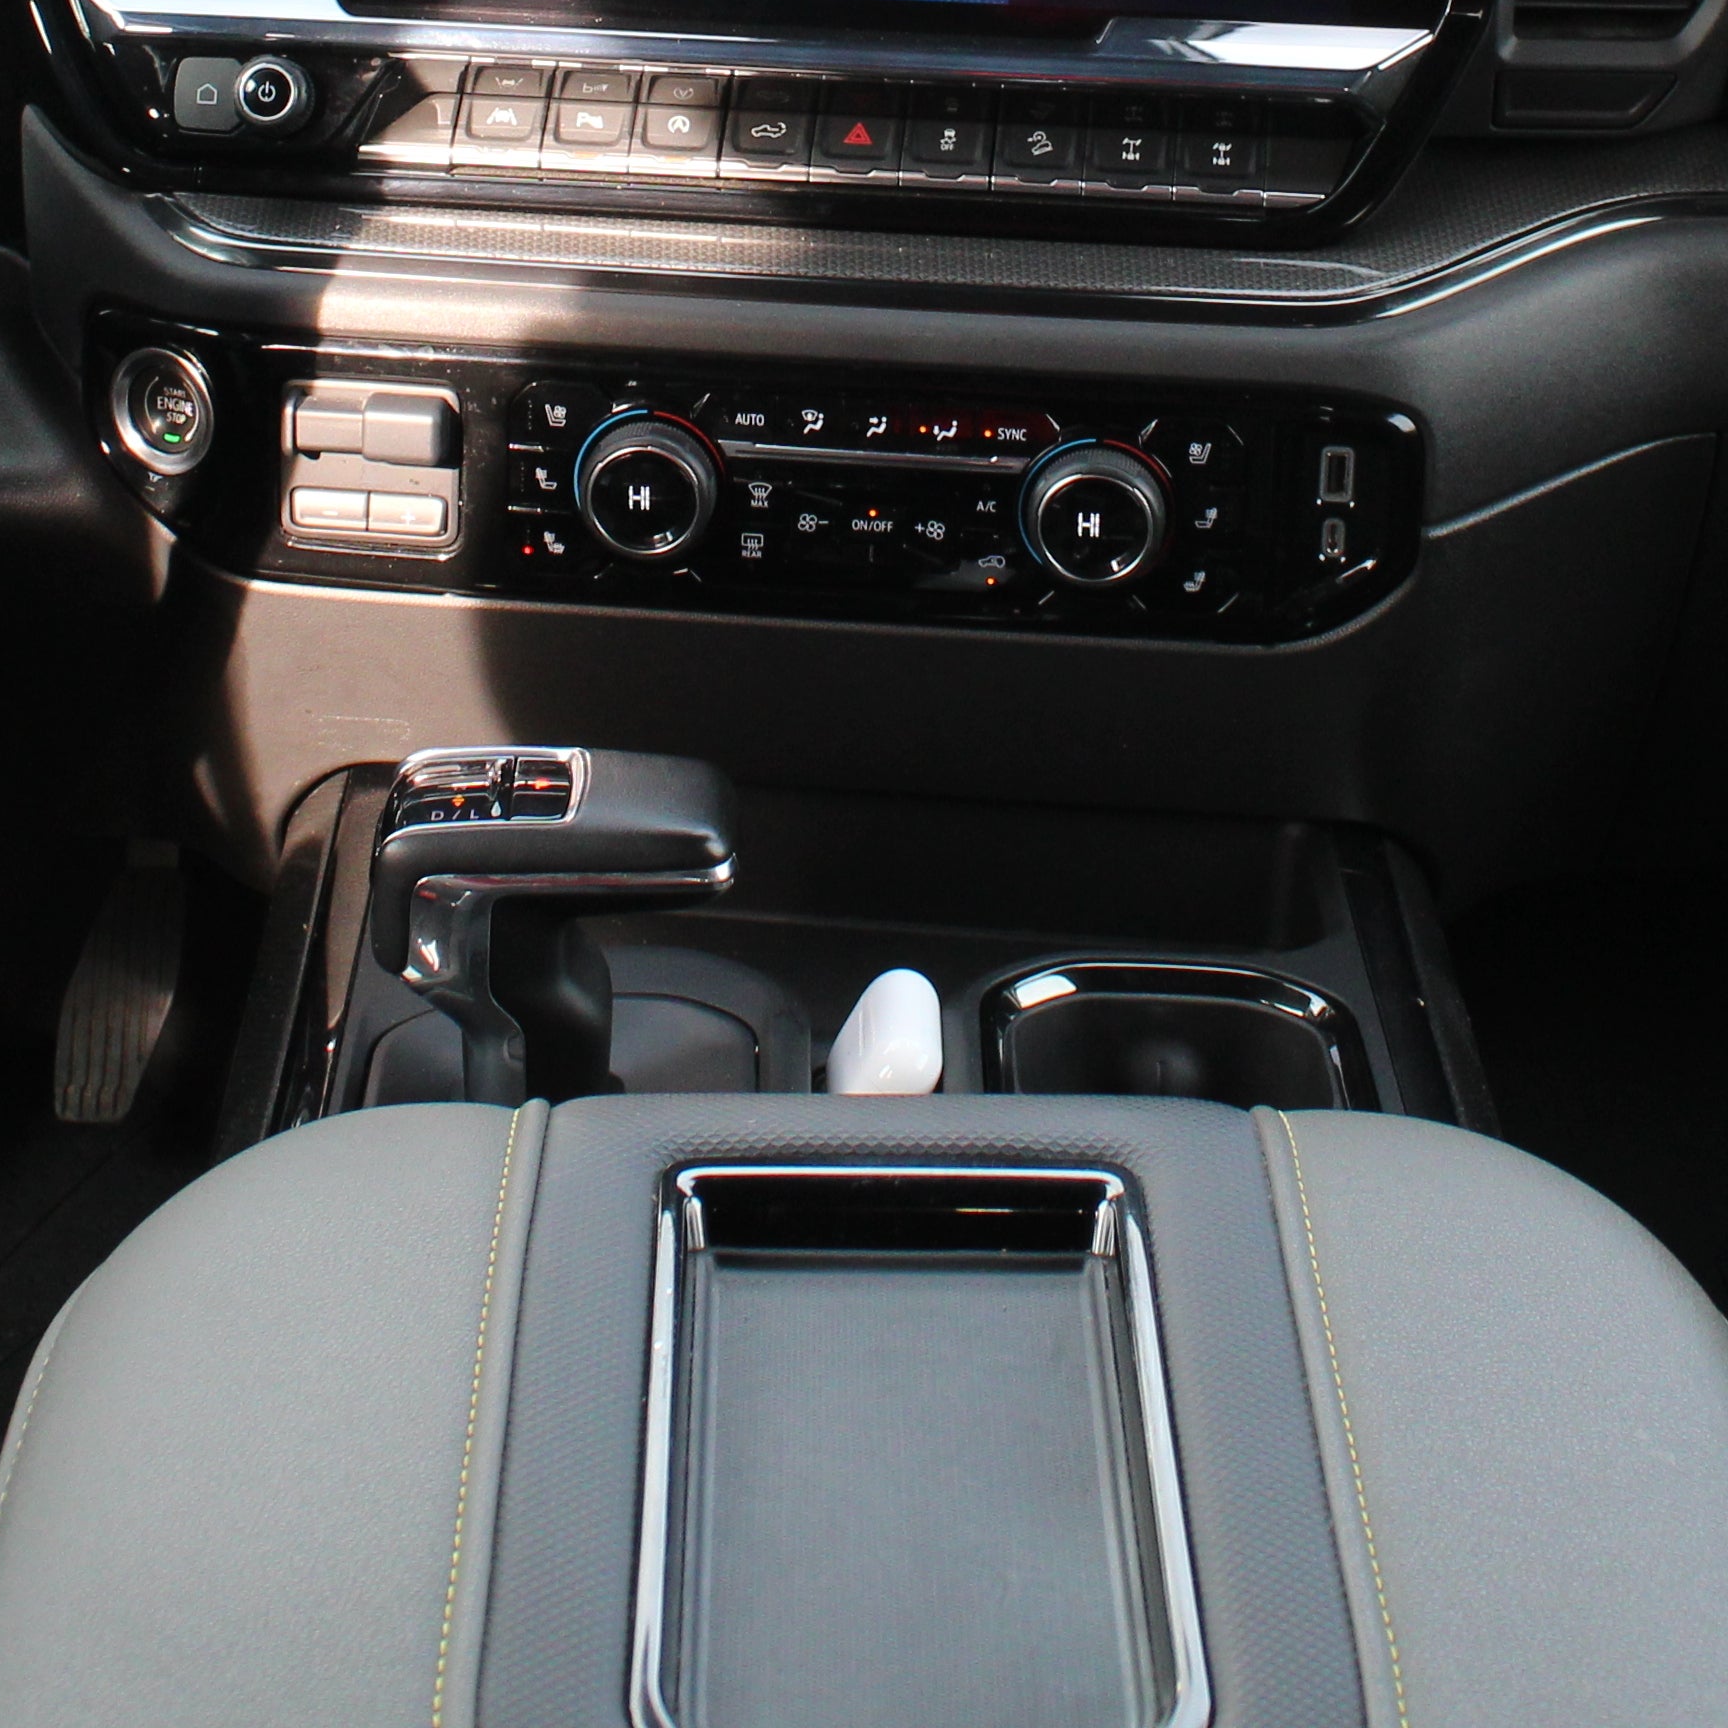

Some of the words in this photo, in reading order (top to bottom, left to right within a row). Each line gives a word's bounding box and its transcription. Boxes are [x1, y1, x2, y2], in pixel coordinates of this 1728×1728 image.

[156, 396, 193, 417] ENGINE
[166, 412, 187, 425] STOP
[735, 413, 765, 427] AUTO
[997, 427, 1027, 441] SYNC
[750, 499, 769, 508] MAX
[976, 501, 997, 512] A/C
[851, 519, 893, 532] ON/OFF
[741, 549, 762, 559] REAR
